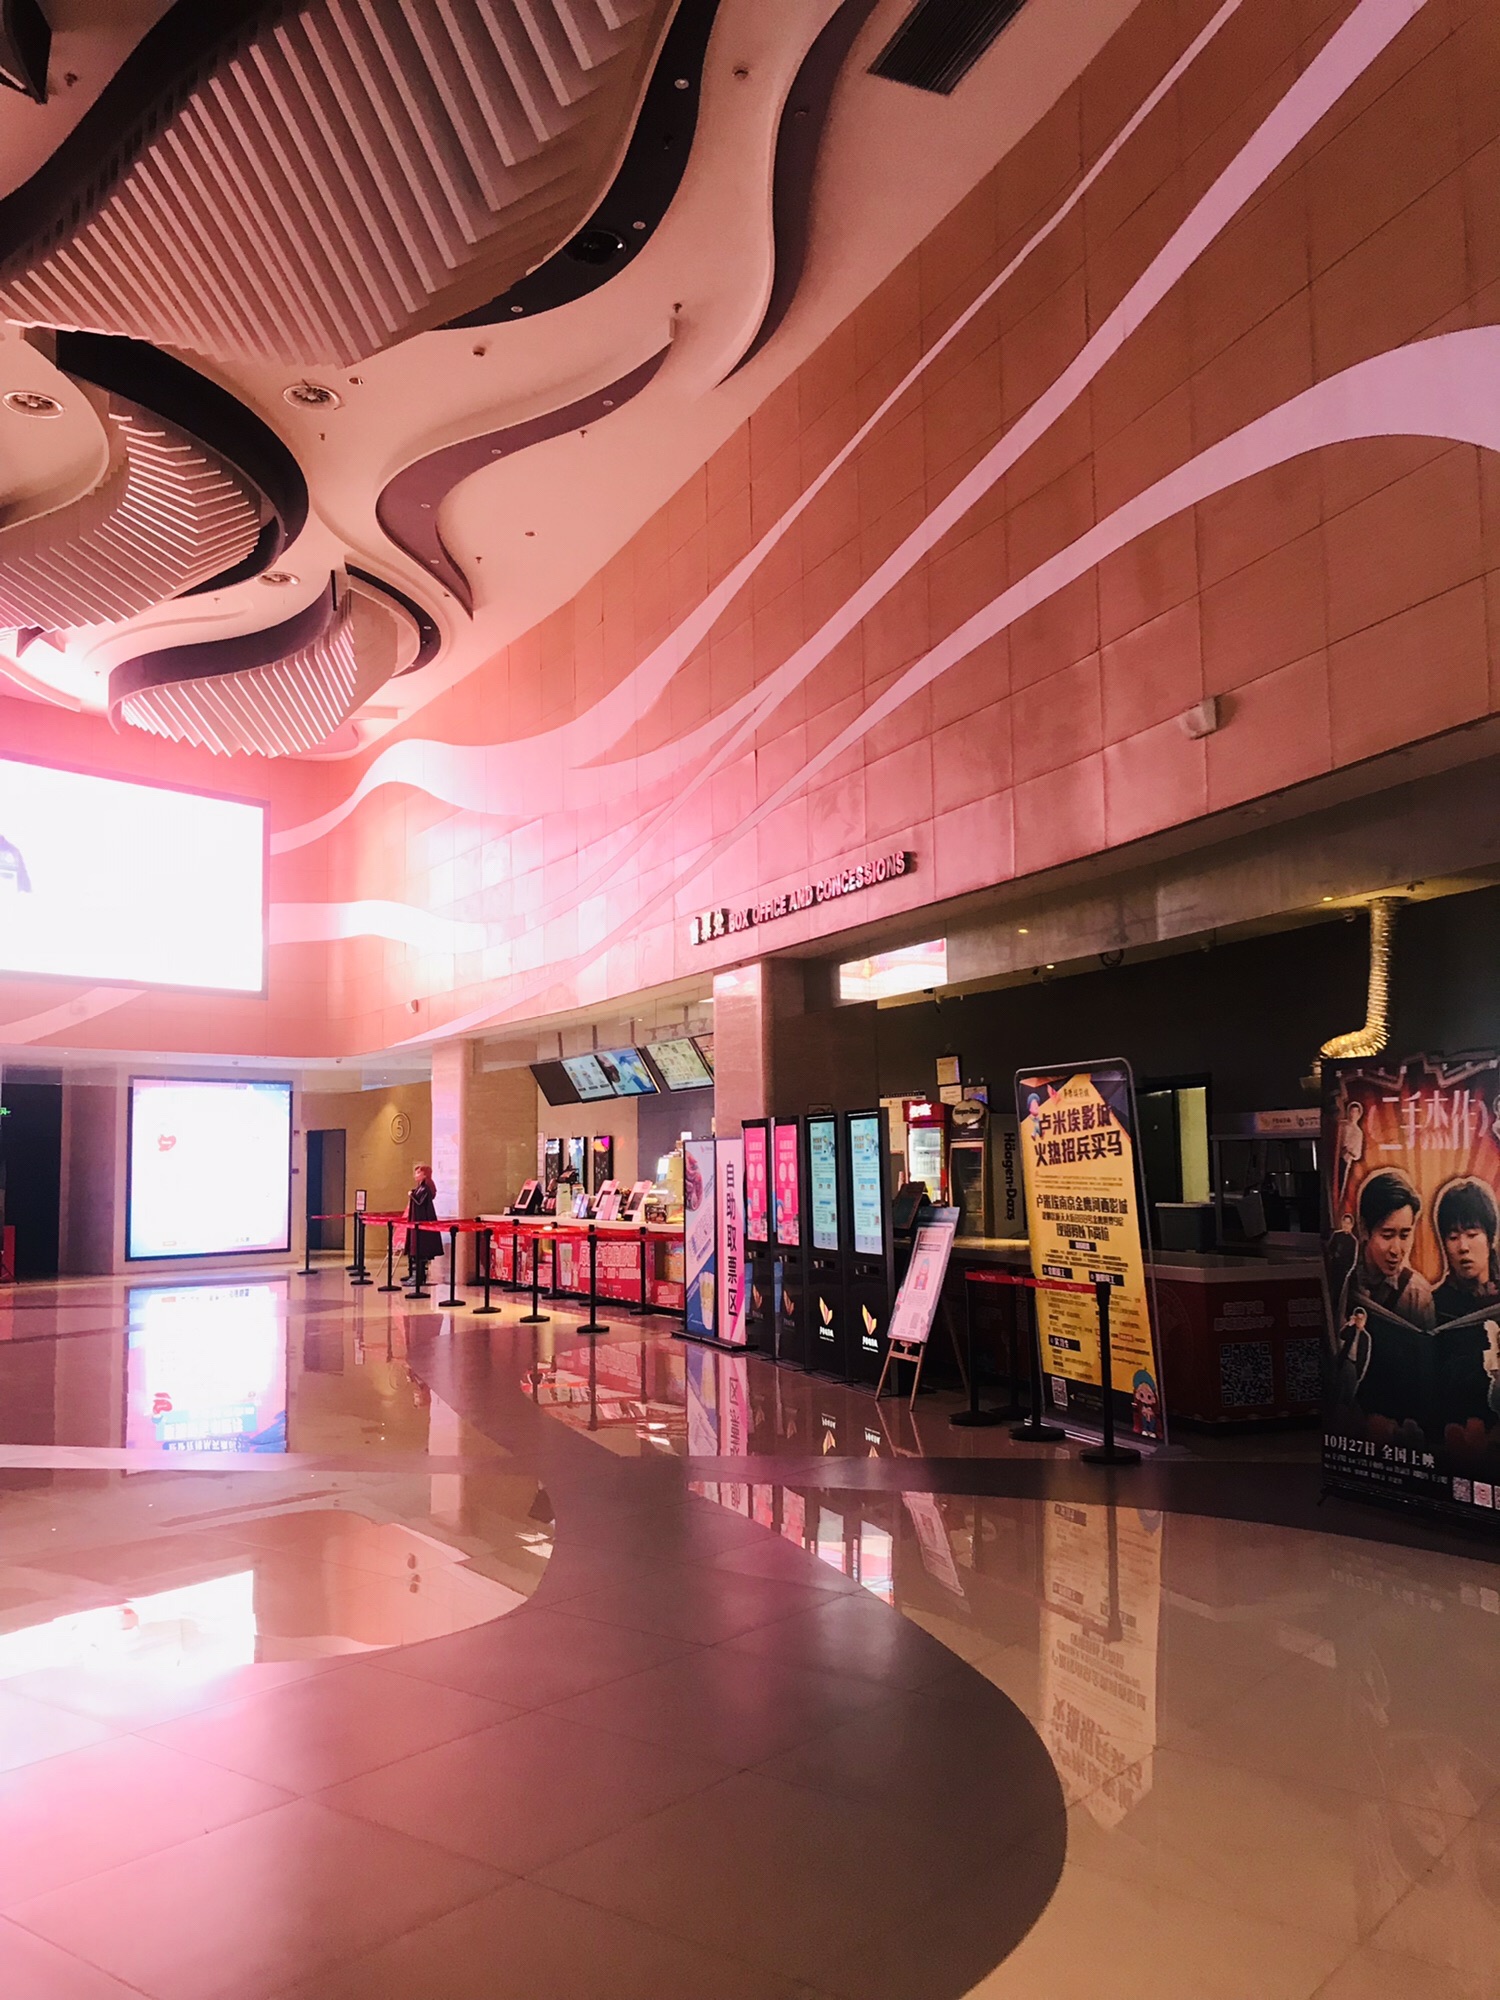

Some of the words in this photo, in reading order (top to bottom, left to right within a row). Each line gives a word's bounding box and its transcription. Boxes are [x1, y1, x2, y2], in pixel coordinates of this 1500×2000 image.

[728, 908, 750, 933] BOX
[752, 896, 787, 924] OFFICE
[788, 885, 814, 911] AND
[815, 850, 906, 902] CONCESSIONS
[1034, 1130, 1123, 1168] 火热招兵买马
[1039, 1102, 1113, 1136] 卢米埃影城
[1378, 1089, 1477, 1151] 二手杰作
[1002, 1132, 1017, 1221] Häagen-Dazs
[726, 1161, 739, 1317] 自助取票区
[1323, 1434, 1376, 1457] 10月27日
[1381, 1444, 1435, 1469] 全国上映
